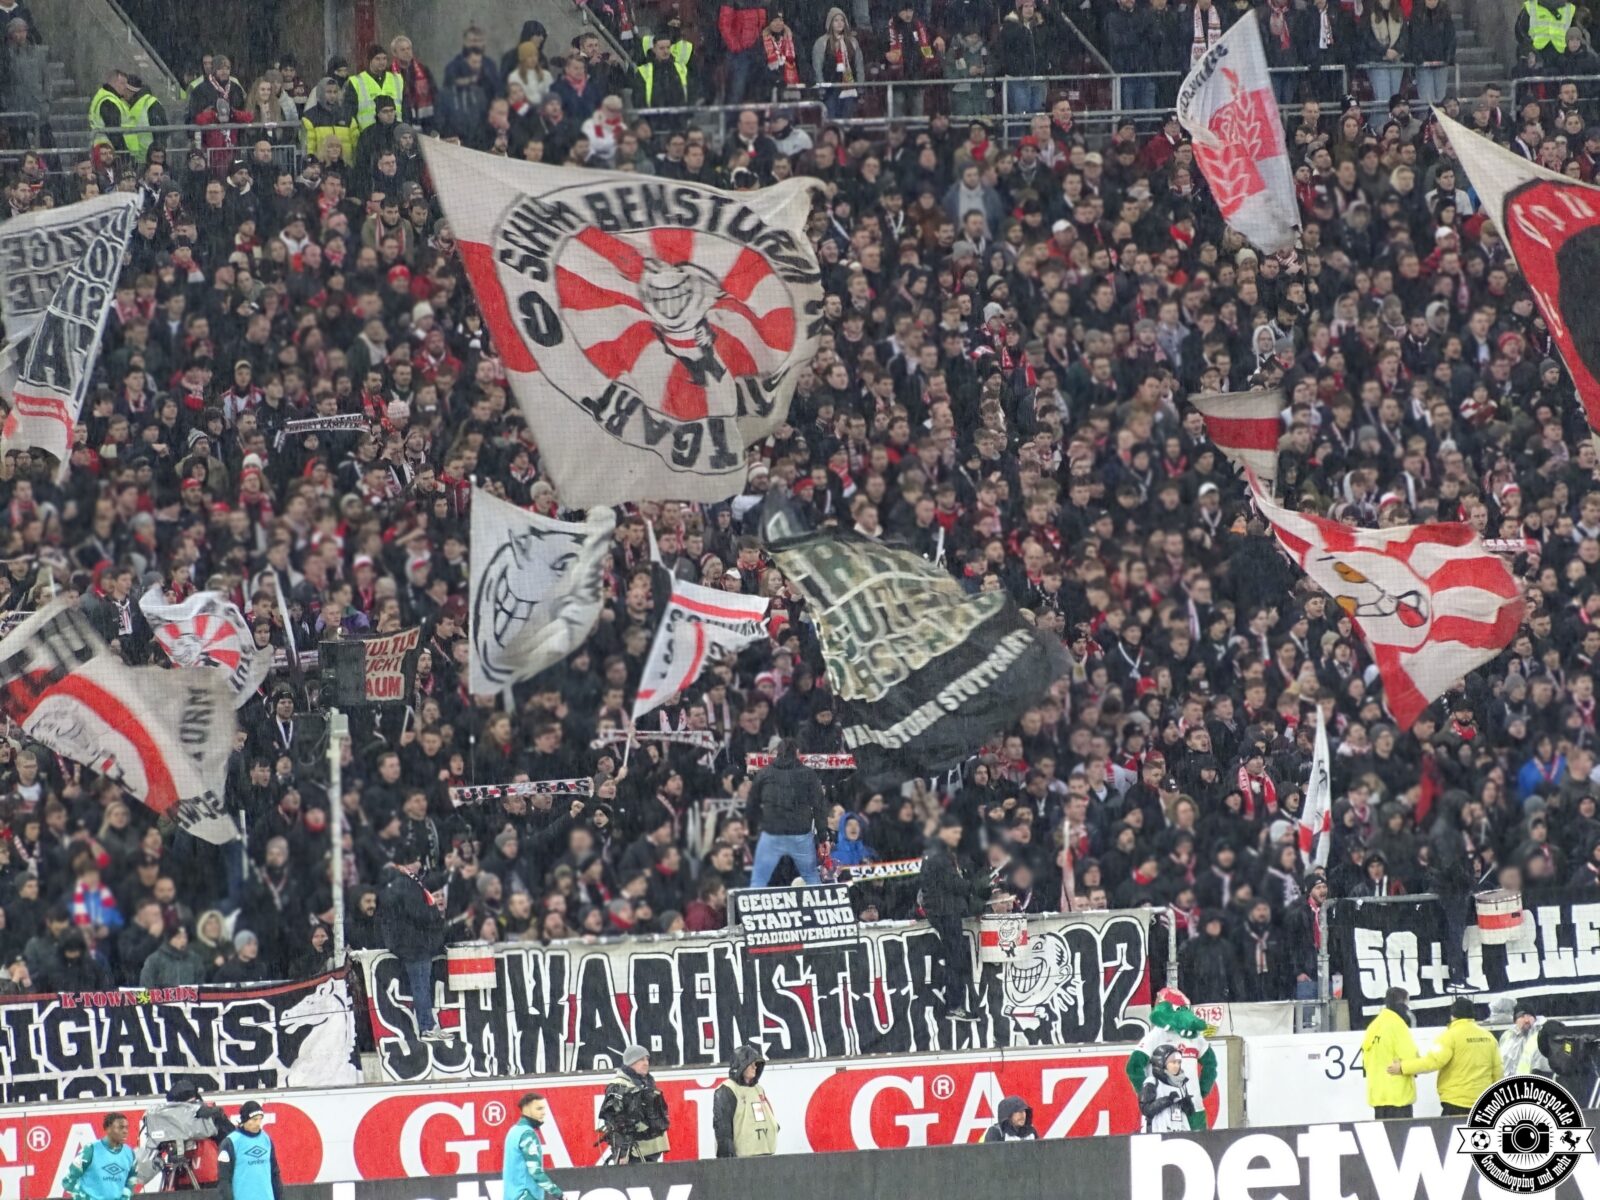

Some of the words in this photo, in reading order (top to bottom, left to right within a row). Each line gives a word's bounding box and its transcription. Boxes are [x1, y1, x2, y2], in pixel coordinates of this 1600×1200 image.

[365, 629, 418, 656] ULTUR
[365, 676, 402, 698] AUM
[737, 891, 798, 912] GEGEN
[802, 886, 851, 907] ALLE
[741, 910, 812, 931] STADT-
[814, 906, 855, 925] UND
[746, 924, 858, 946] STADIONVERBOTE!
[60, 990, 138, 1009] K-TOWN
[148, 985, 200, 1004] REDS
[0, 1001, 277, 1074] IGANS
[754, 1128, 769, 1140] TV
